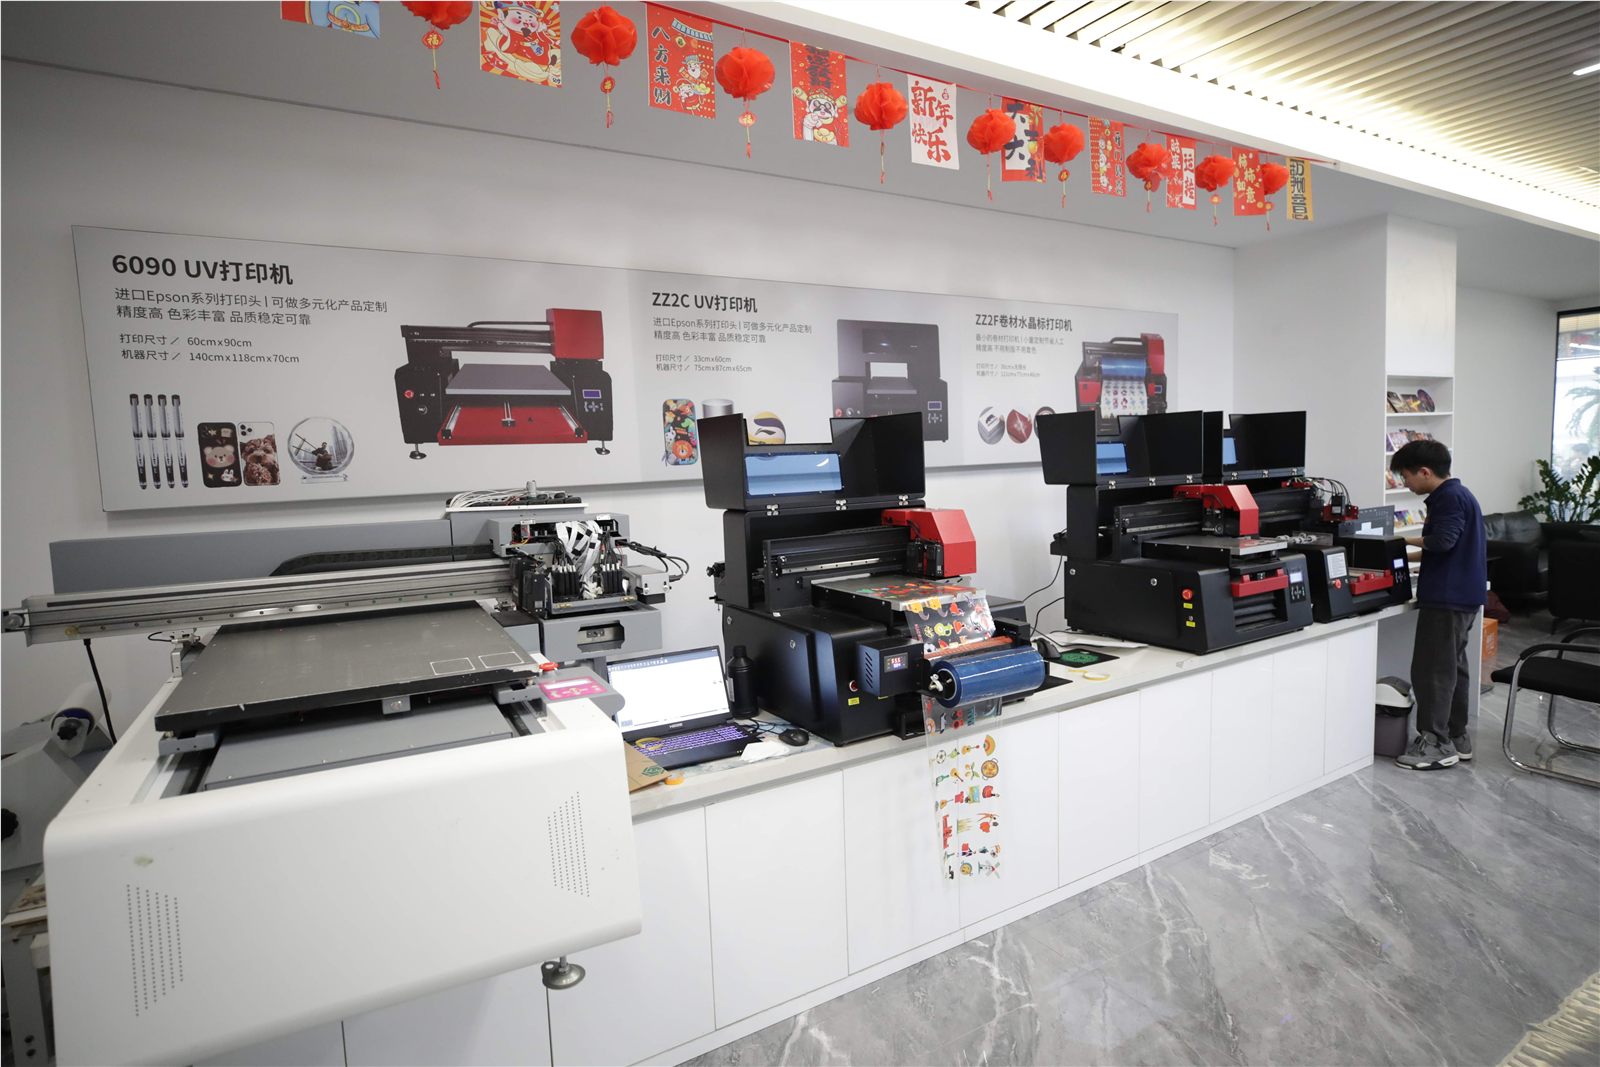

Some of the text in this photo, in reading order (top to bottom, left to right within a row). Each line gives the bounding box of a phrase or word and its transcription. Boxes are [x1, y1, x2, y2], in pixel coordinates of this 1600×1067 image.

[651, 26, 671, 106] 八方来财
[112, 254, 294, 286] 6090 UV打印机
[114, 287, 262, 308] 进口Epson系列打印头
[271, 295, 388, 314] 可做多元化产品定制
[651, 292, 758, 313] ZZ2C UV打印机
[116, 305, 311, 326] 精度高 色彩丰富 品质稳定可靠
[975, 313, 1073, 332] ZZ2F卷材水晶标打印机
[654, 330, 767, 343] 精度高 色彩丰富 品质稳定可靠
